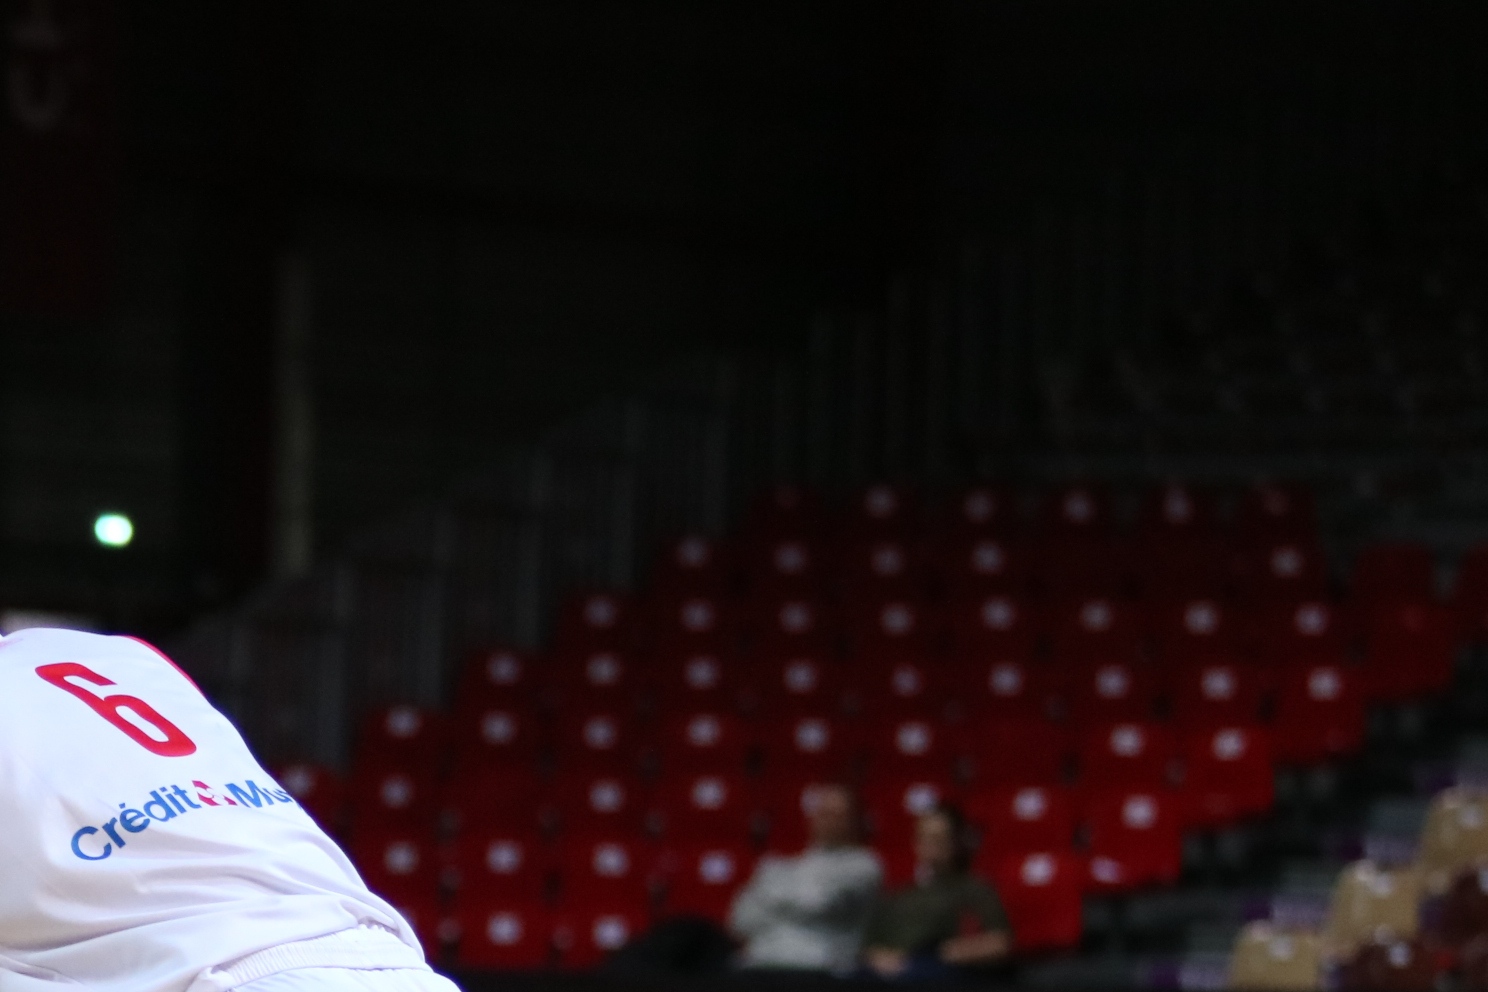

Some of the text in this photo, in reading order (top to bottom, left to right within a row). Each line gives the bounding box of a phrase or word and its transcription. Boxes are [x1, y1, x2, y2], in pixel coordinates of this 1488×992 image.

[35, 662, 197, 757] 6
[71, 779, 296, 860] Crédit Mu
